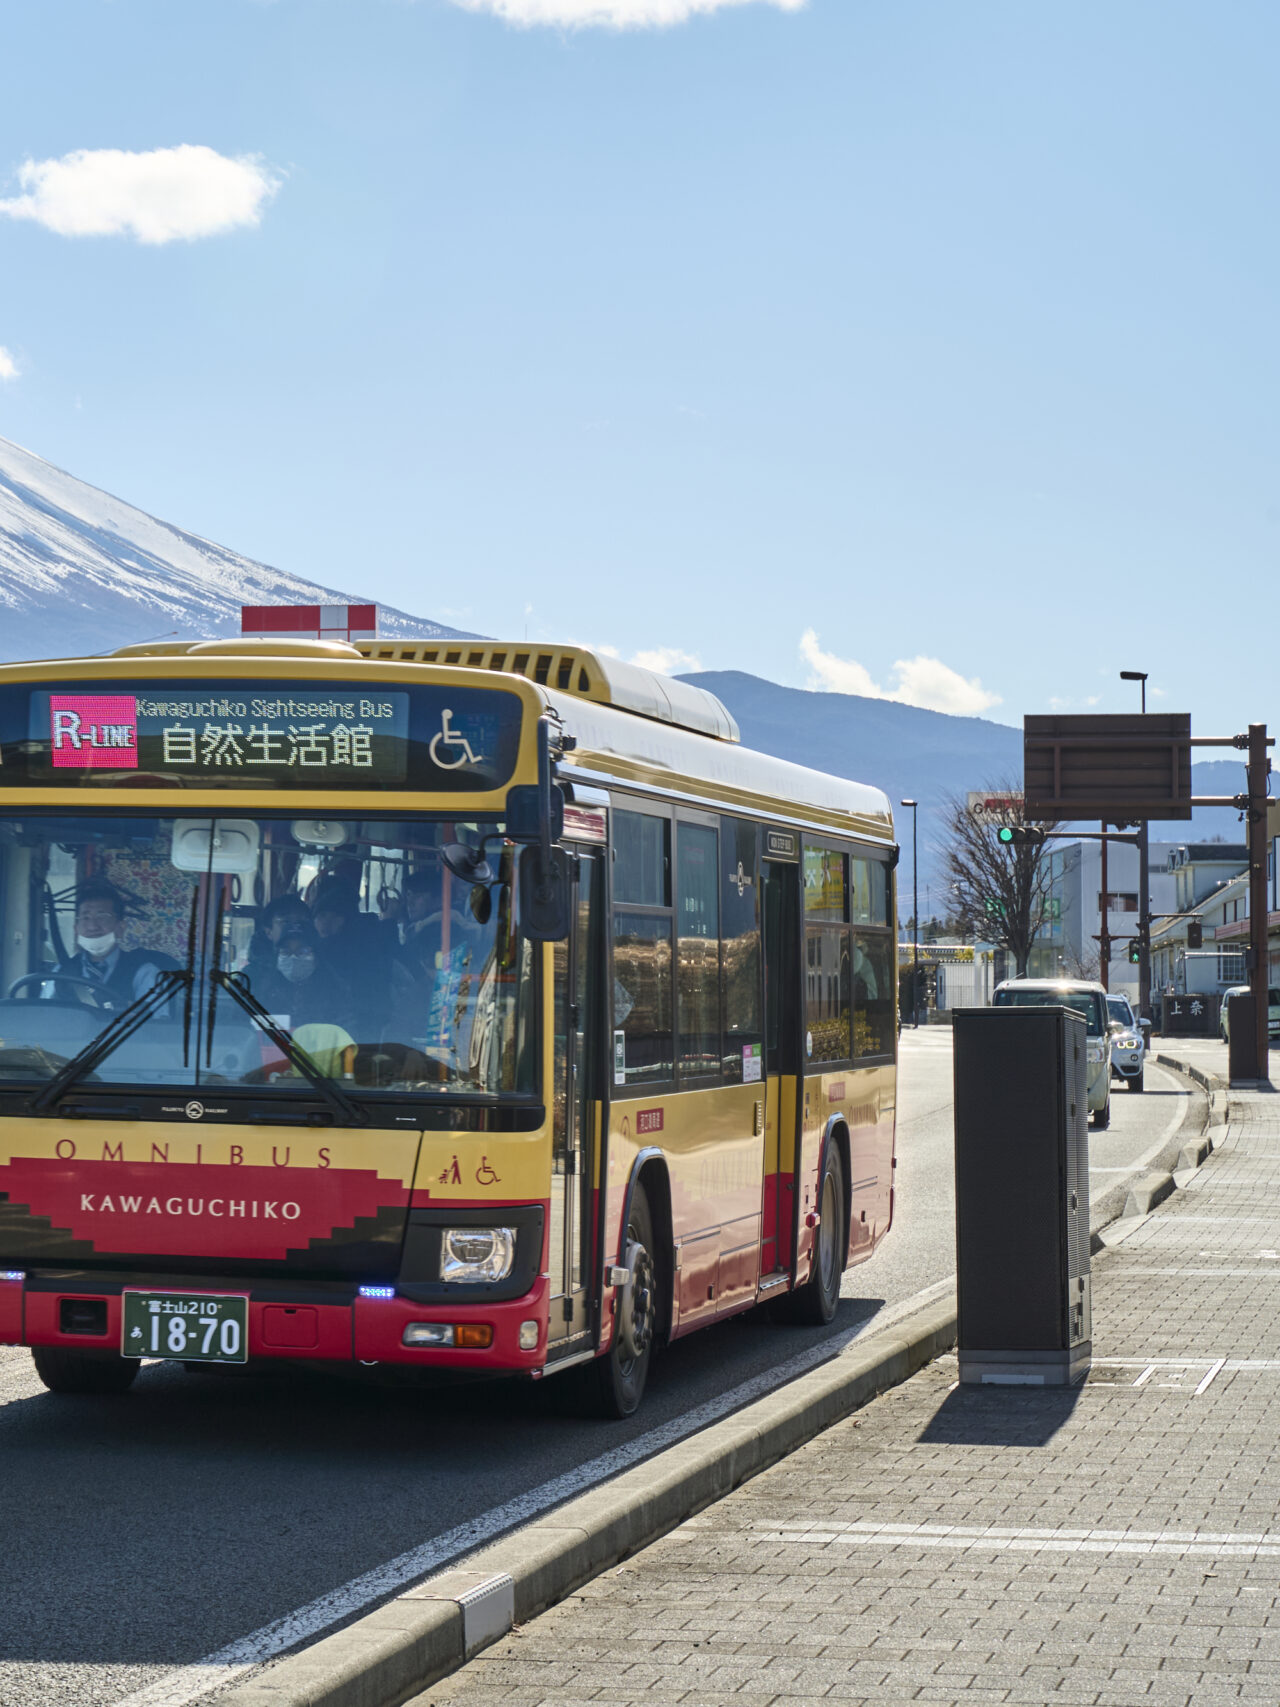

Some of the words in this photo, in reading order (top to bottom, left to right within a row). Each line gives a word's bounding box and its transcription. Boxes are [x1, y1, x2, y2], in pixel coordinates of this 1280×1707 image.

[135, 698, 247, 719] Kawaguchiko
[251, 698, 356, 719] Sightseeing
[359, 699, 394, 718] Bus
[52, 710, 135, 749] R-LINE
[163, 722, 374, 767] 自然生活館
[55, 1139, 331, 1169] OMNIBUS
[80, 1194, 301, 1220] KAWAGUCHIKO
[148, 1300, 218, 1316] 富士山210
[130, 1326, 143, 1339] あ
[151, 1315, 240, 1355] 18-70
